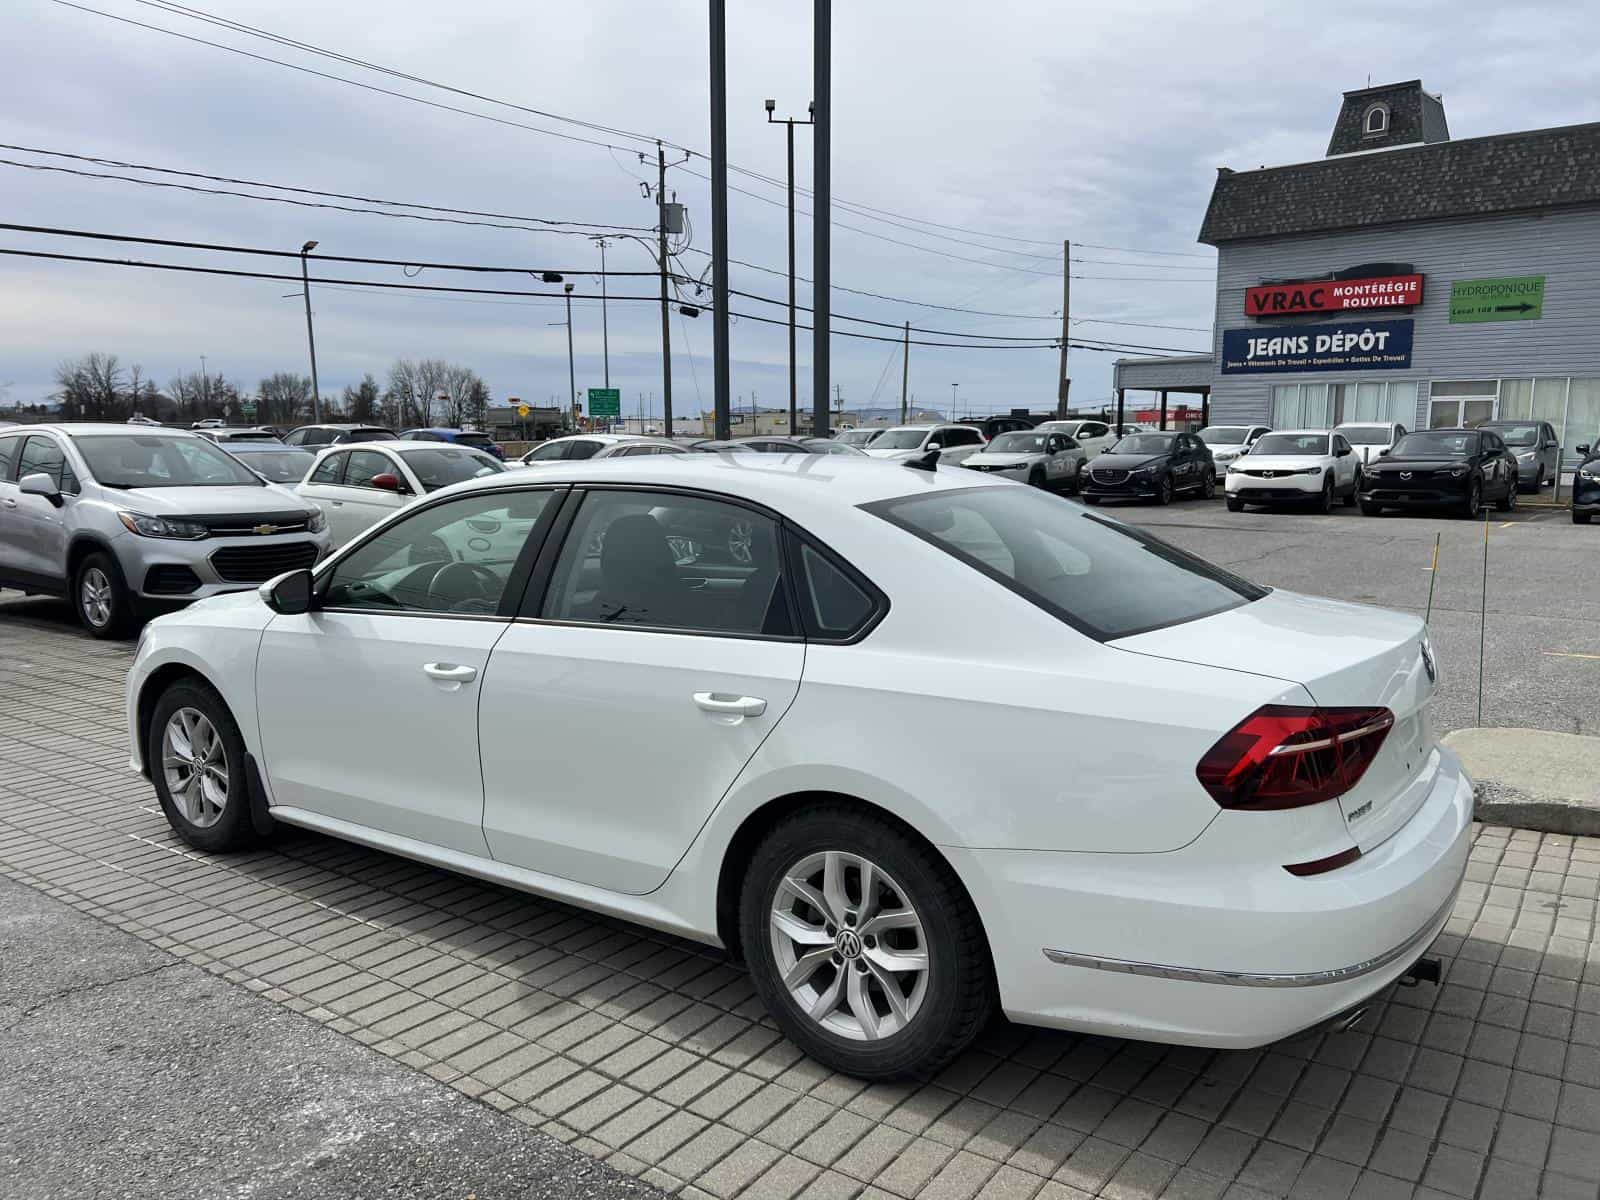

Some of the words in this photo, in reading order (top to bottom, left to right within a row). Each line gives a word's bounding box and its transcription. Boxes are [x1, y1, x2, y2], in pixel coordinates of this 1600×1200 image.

[1333, 282, 1417, 297] MONTÉRÉGIE
[1453, 281, 1540, 297] HYDROPONIQUE
[1252, 288, 1325, 312] VRAC
[1343, 294, 1405, 309] ROUVILLE
[1246, 335, 1309, 360] JEANS
[1315, 328, 1390, 353] DÉPÔT
